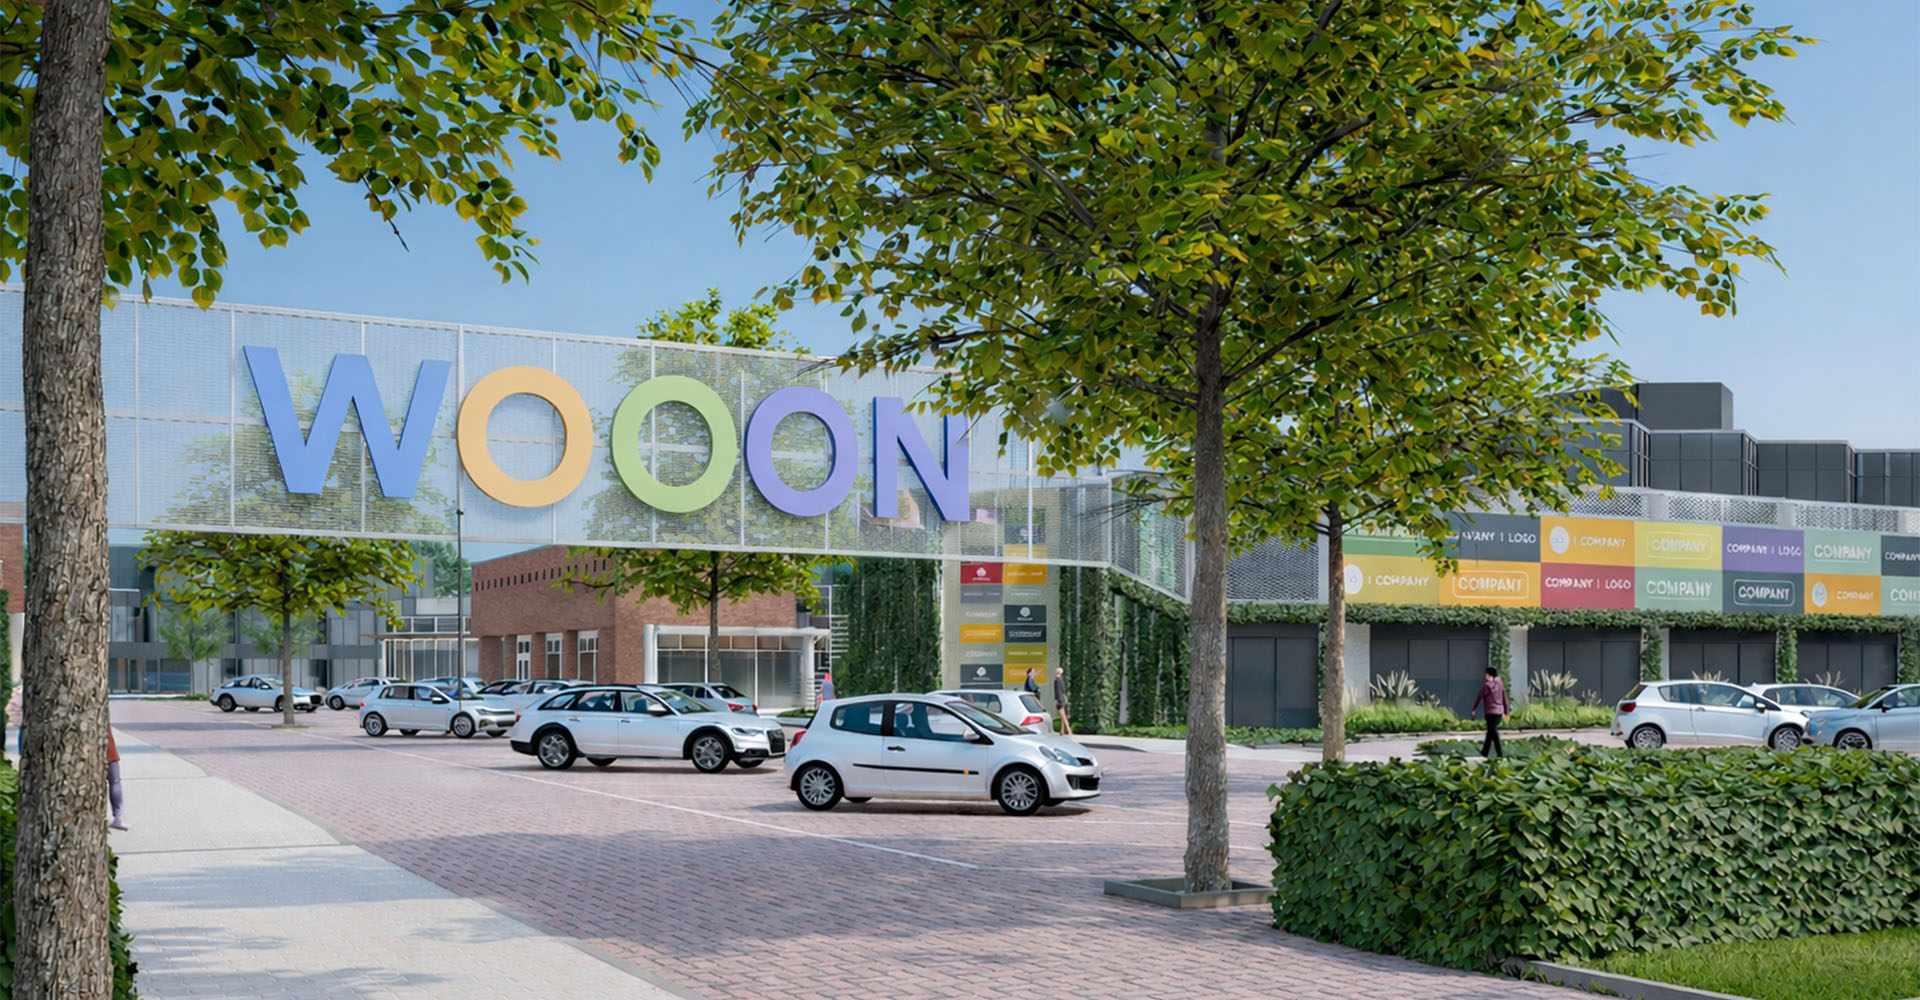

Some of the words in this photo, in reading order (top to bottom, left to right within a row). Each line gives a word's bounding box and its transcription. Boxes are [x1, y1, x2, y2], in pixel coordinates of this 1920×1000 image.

[243, 345, 970, 522] WOOON
[1727, 543, 1767, 555] COMPANY
[1814, 544, 1872, 560] COMPANY
[1375, 574, 1429, 586] COMPANY
[1545, 576, 1594, 588] COMPANY
[1647, 579, 1712, 597] COMPANY
[1738, 585, 1790, 600] COMPANY
